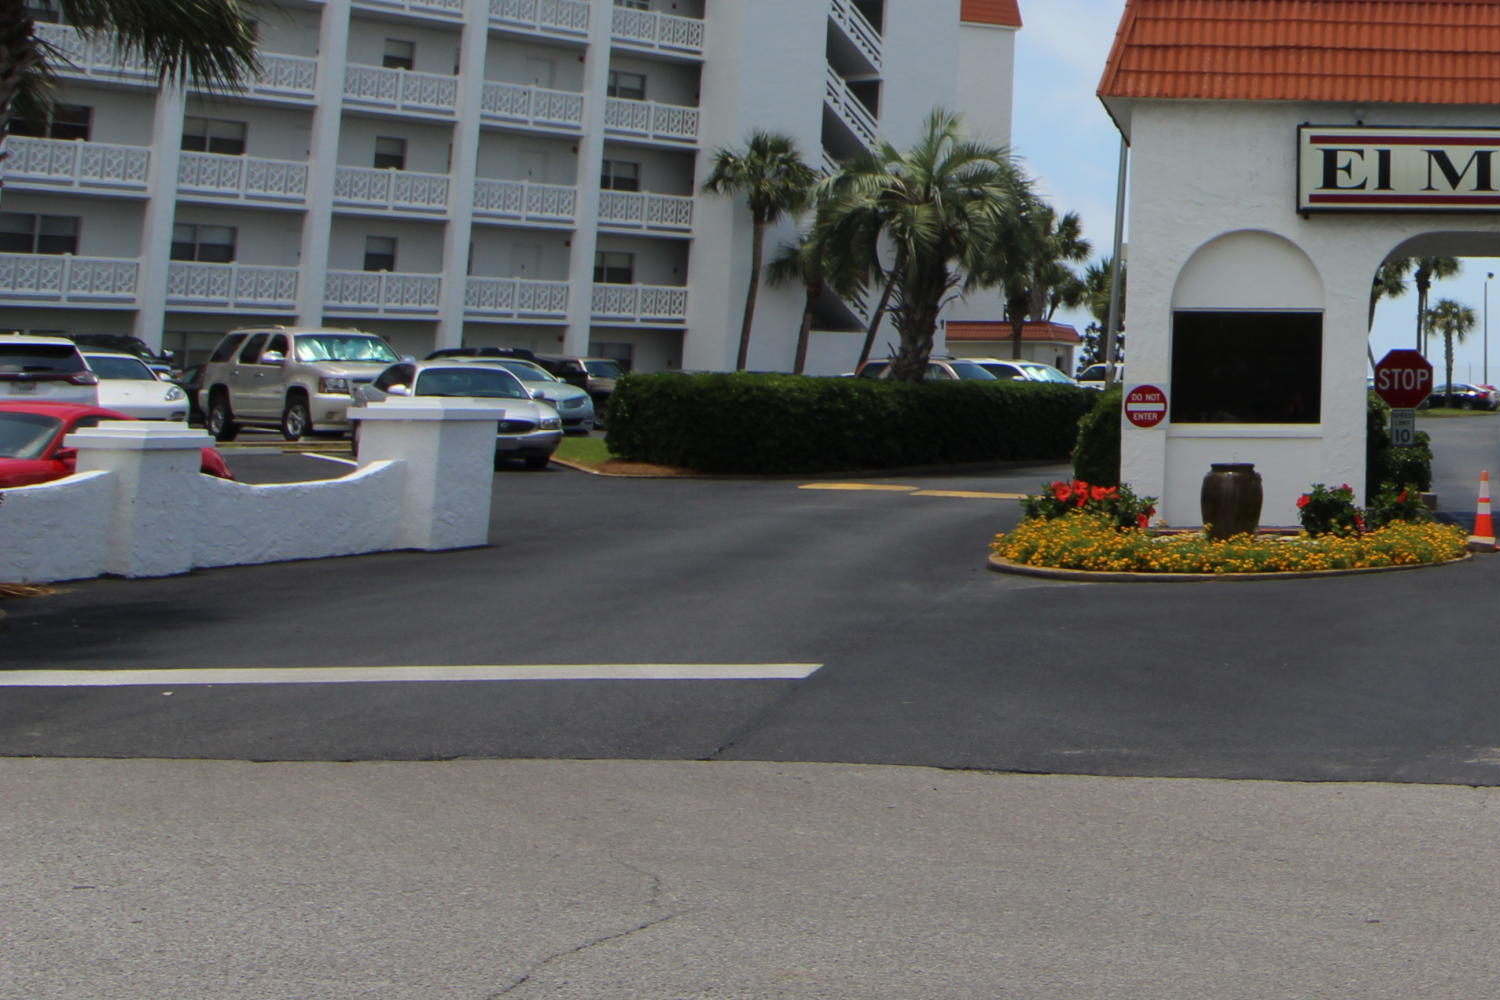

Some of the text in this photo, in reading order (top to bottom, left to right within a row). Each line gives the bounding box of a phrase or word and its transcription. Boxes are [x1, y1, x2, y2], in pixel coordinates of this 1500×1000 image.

[1315, 147, 1395, 191] El
[1378, 368, 1429, 390] STOP
[1131, 393, 1160, 401] DO NOT
[1133, 412, 1158, 420] ENTER
[1395, 429, 1410, 442] 10
